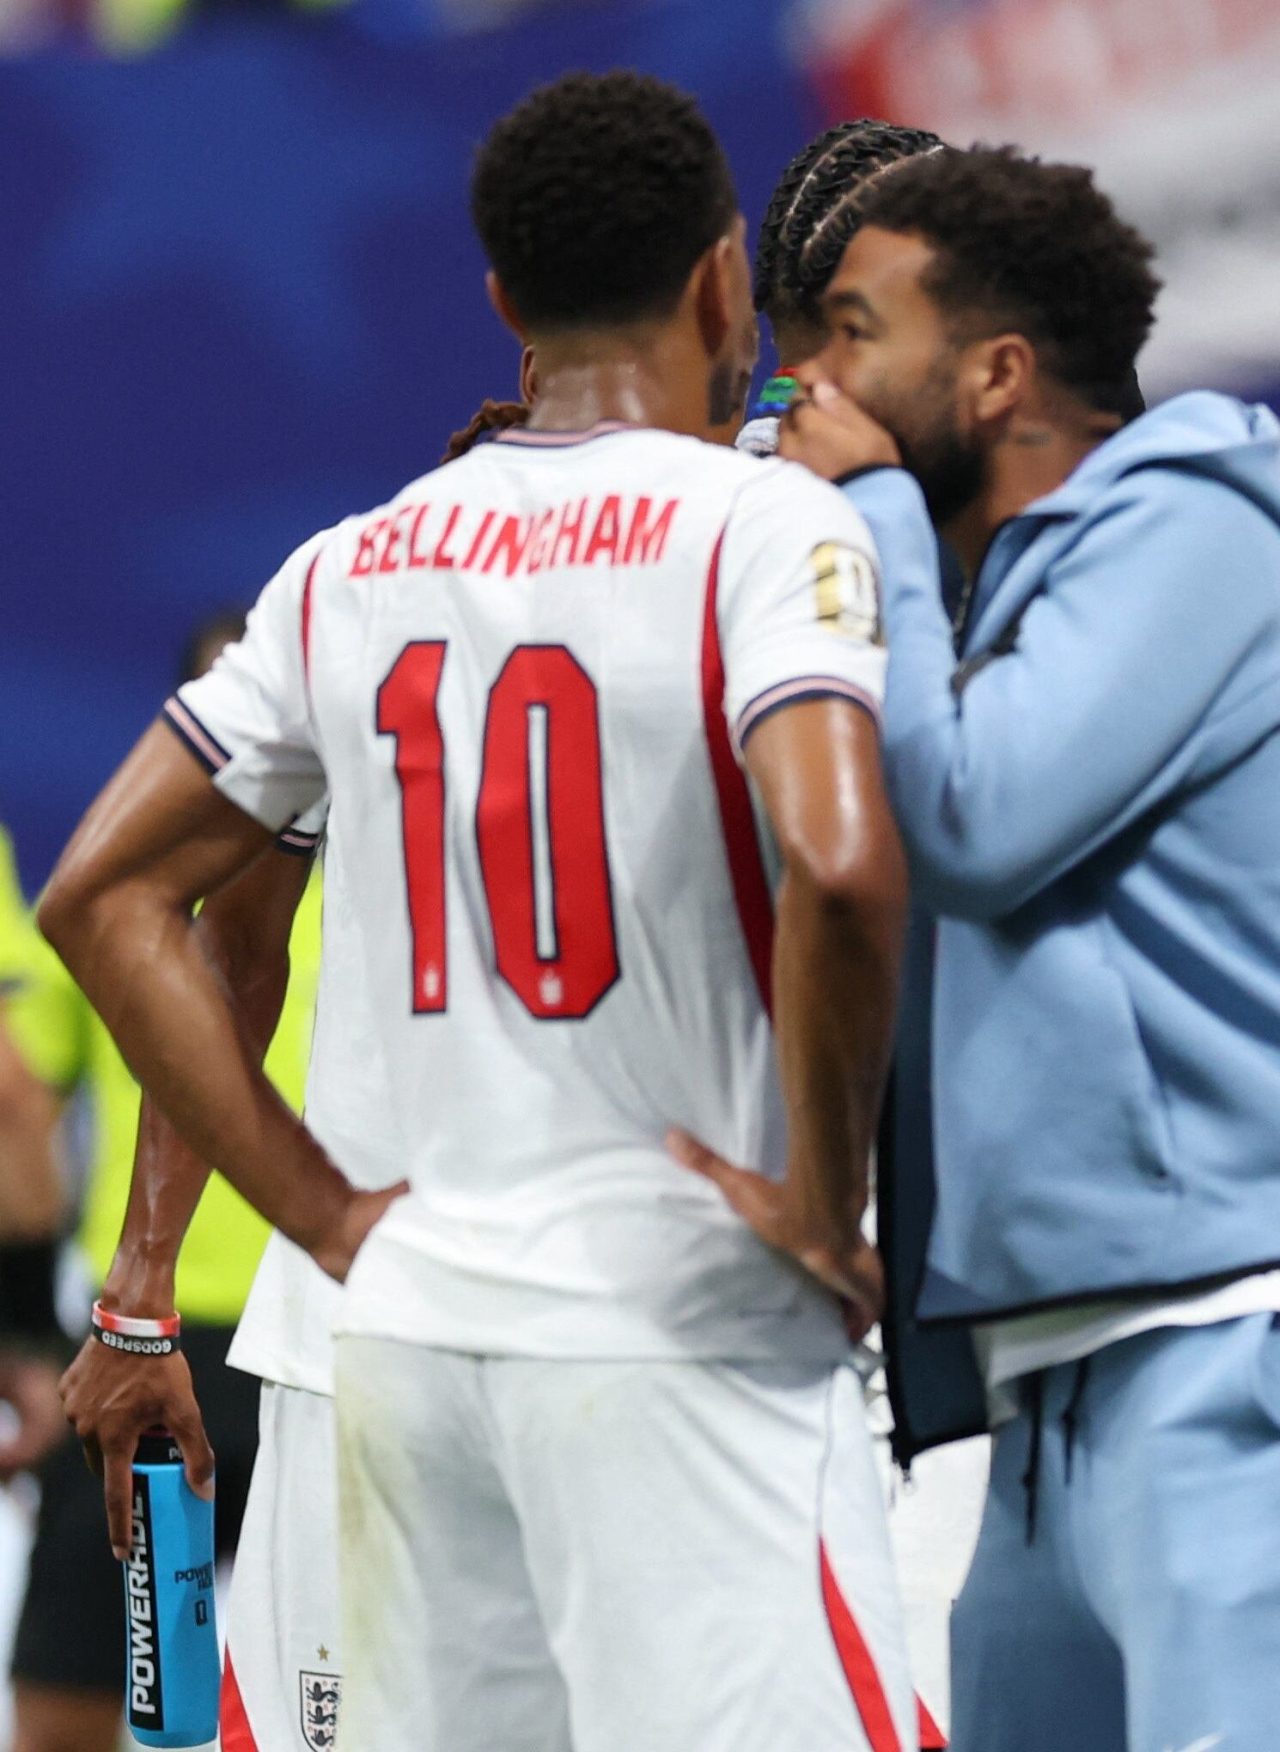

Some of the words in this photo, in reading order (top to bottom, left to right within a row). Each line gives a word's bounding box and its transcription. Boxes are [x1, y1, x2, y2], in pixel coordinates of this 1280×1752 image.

[349, 495, 679, 578] BELLINGHAM
[376, 640, 621, 1020] 10
[101, 1331, 172, 1354] GODSPEED
